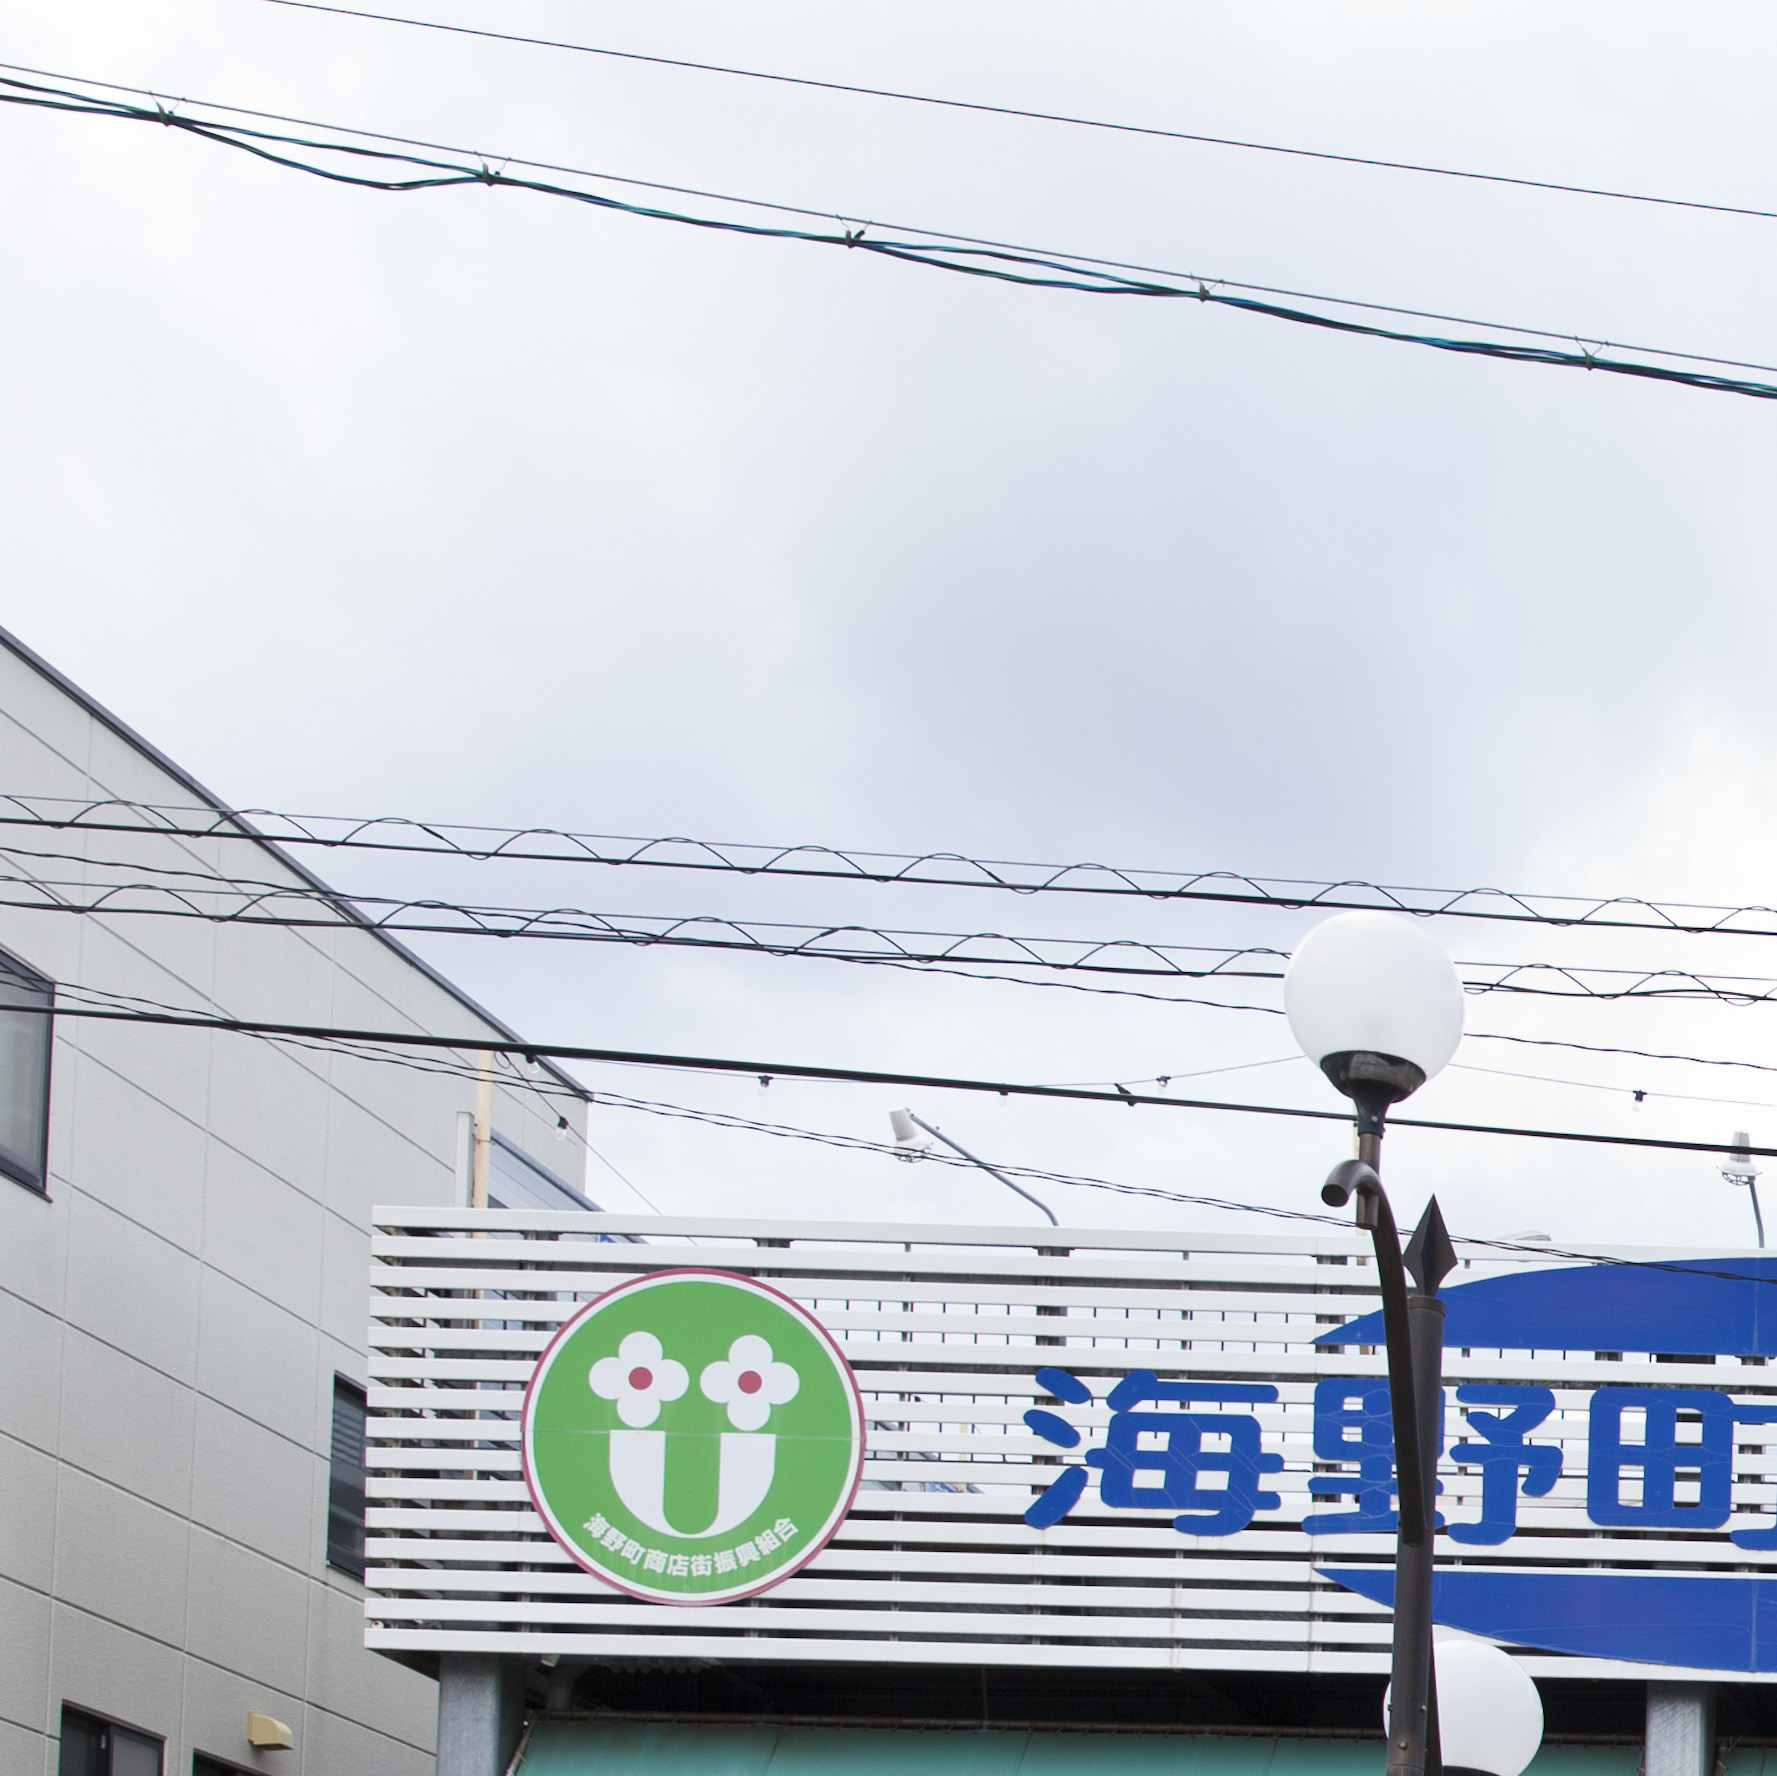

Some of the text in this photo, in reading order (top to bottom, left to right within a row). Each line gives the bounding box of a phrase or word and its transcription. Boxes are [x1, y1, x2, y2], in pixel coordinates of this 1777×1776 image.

[583, 1512, 800, 1577] 海野町商店街振興組合
